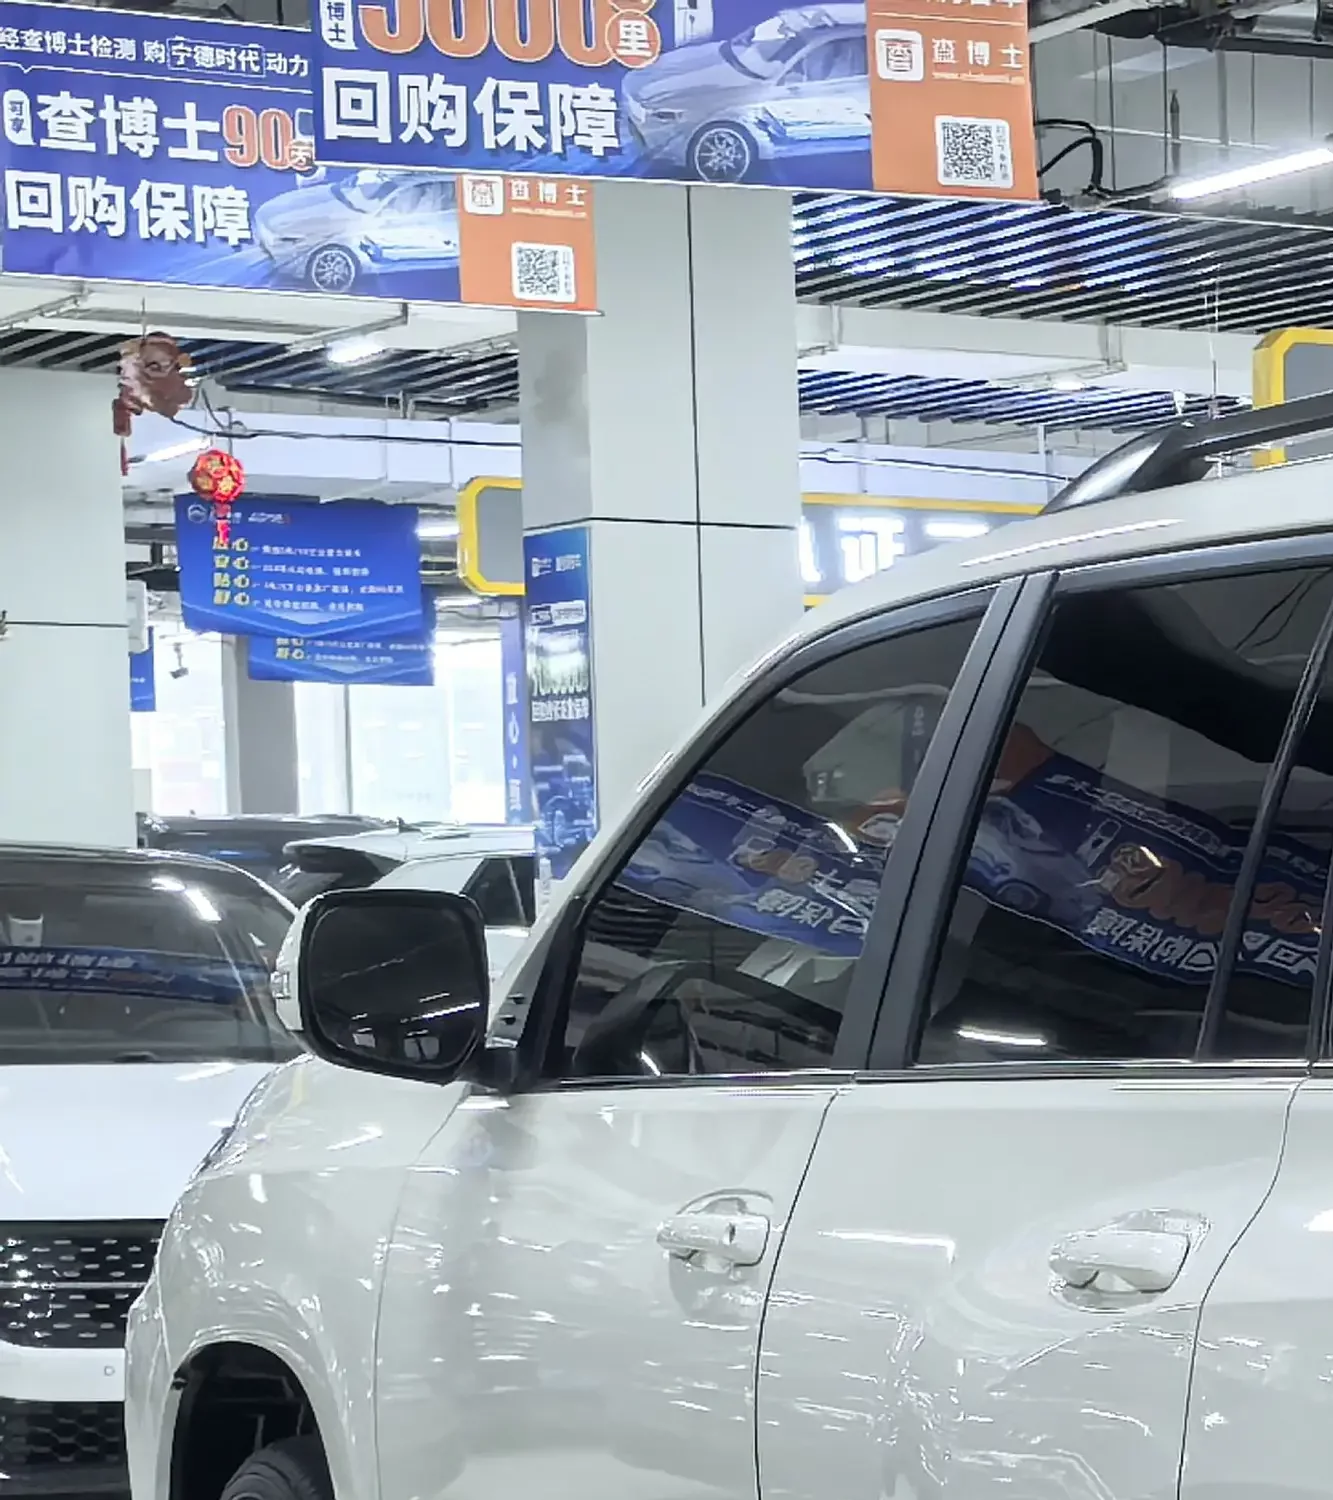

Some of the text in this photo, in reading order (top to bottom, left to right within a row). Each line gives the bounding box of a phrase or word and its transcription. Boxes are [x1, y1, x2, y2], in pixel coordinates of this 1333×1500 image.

[322, 66, 621, 157] 回购保障
[4, 168, 252, 247] 回购保障
